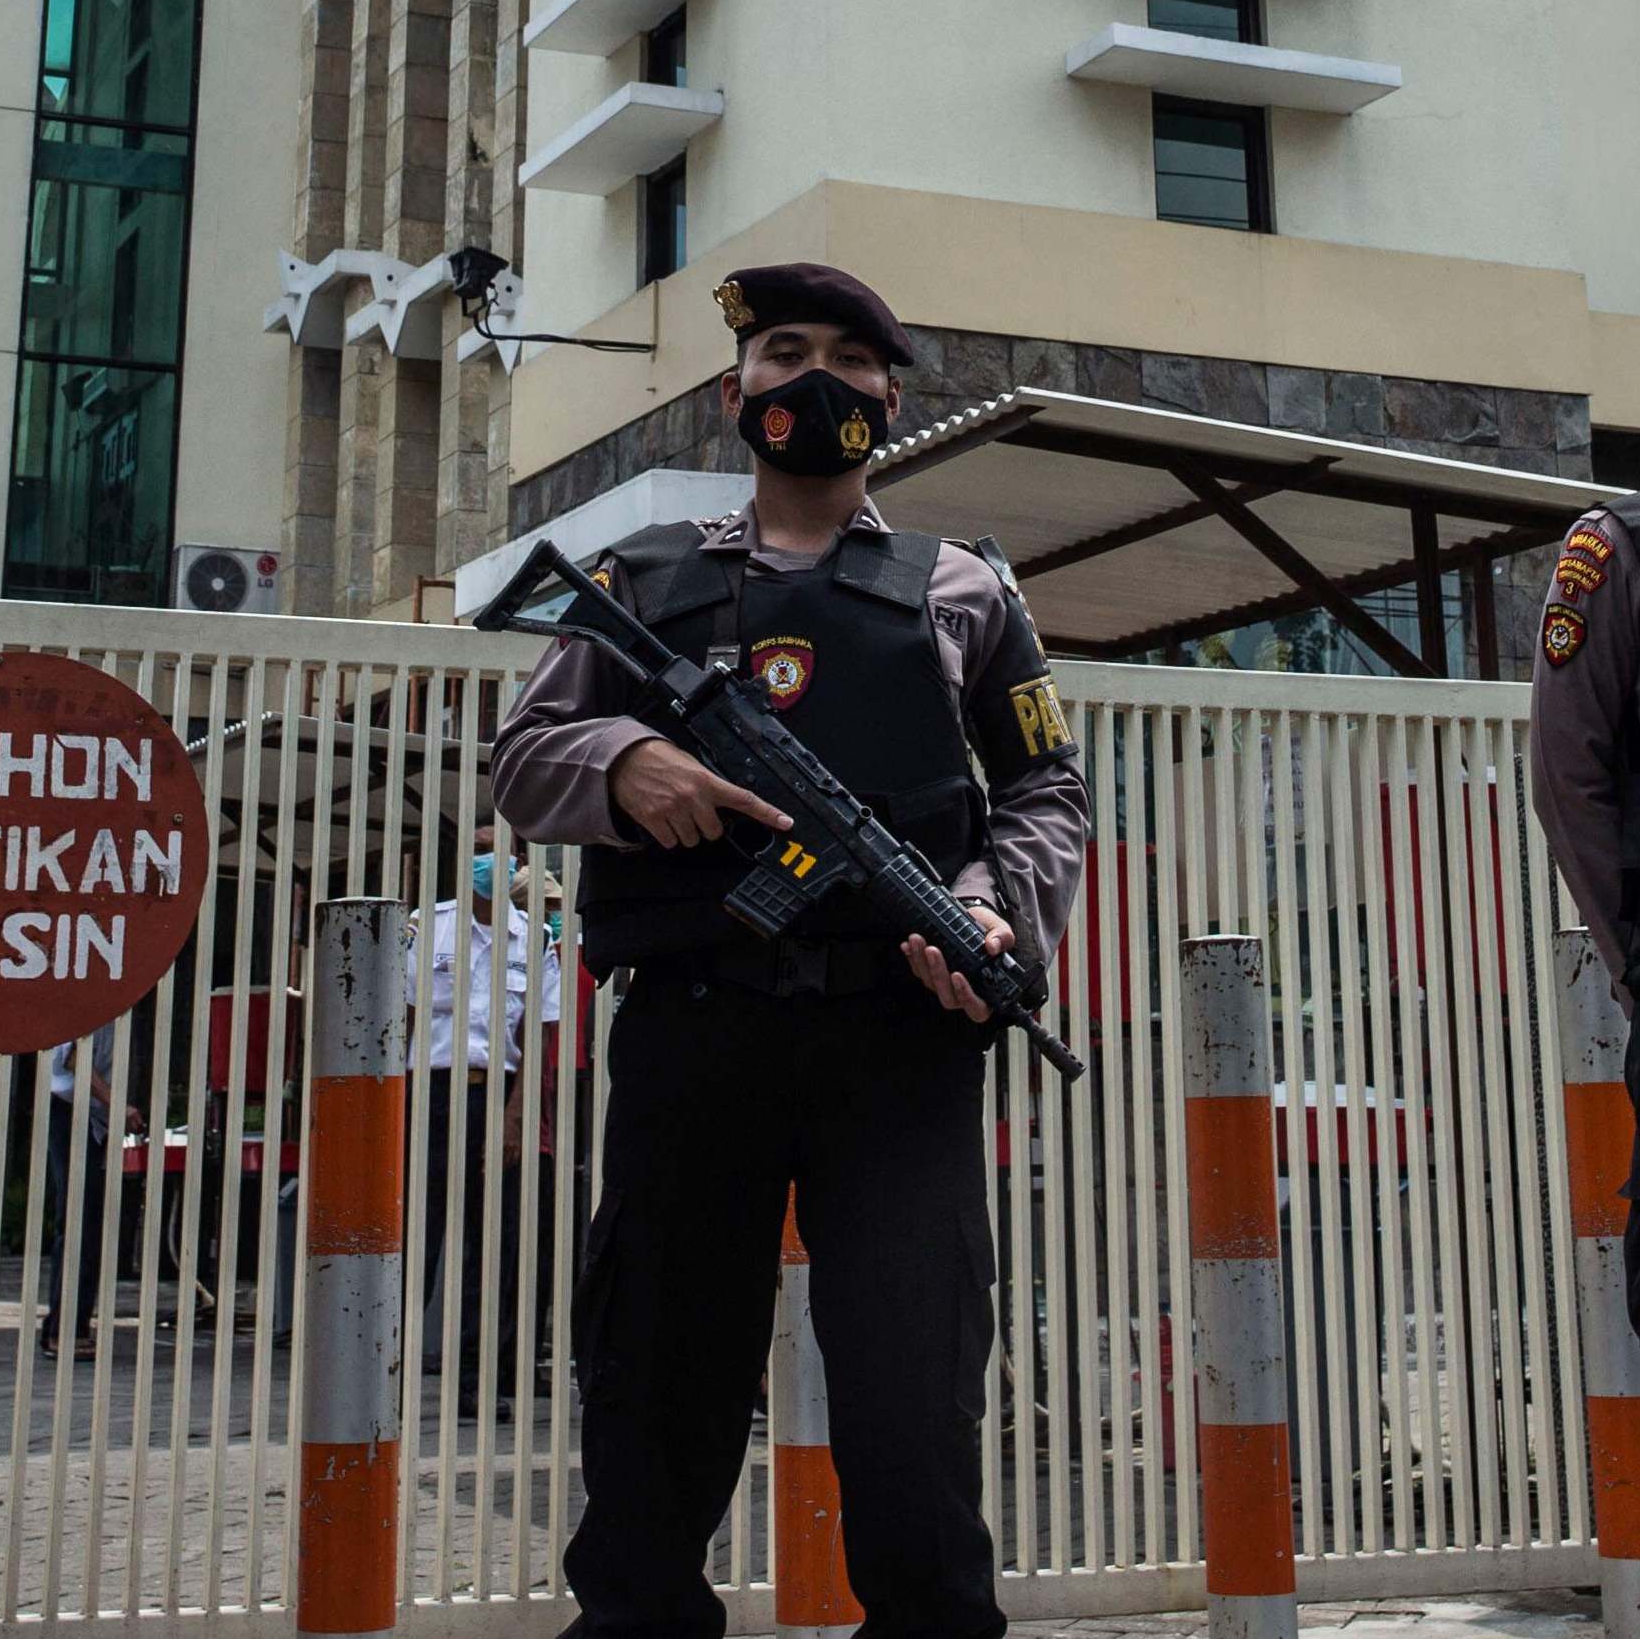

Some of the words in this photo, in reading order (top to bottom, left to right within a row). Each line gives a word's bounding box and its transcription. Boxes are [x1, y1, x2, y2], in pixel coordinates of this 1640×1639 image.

[257, 577, 274, 588] LG
[1565, 581, 1574, 594] 3
[780, 840, 817, 879] 11
